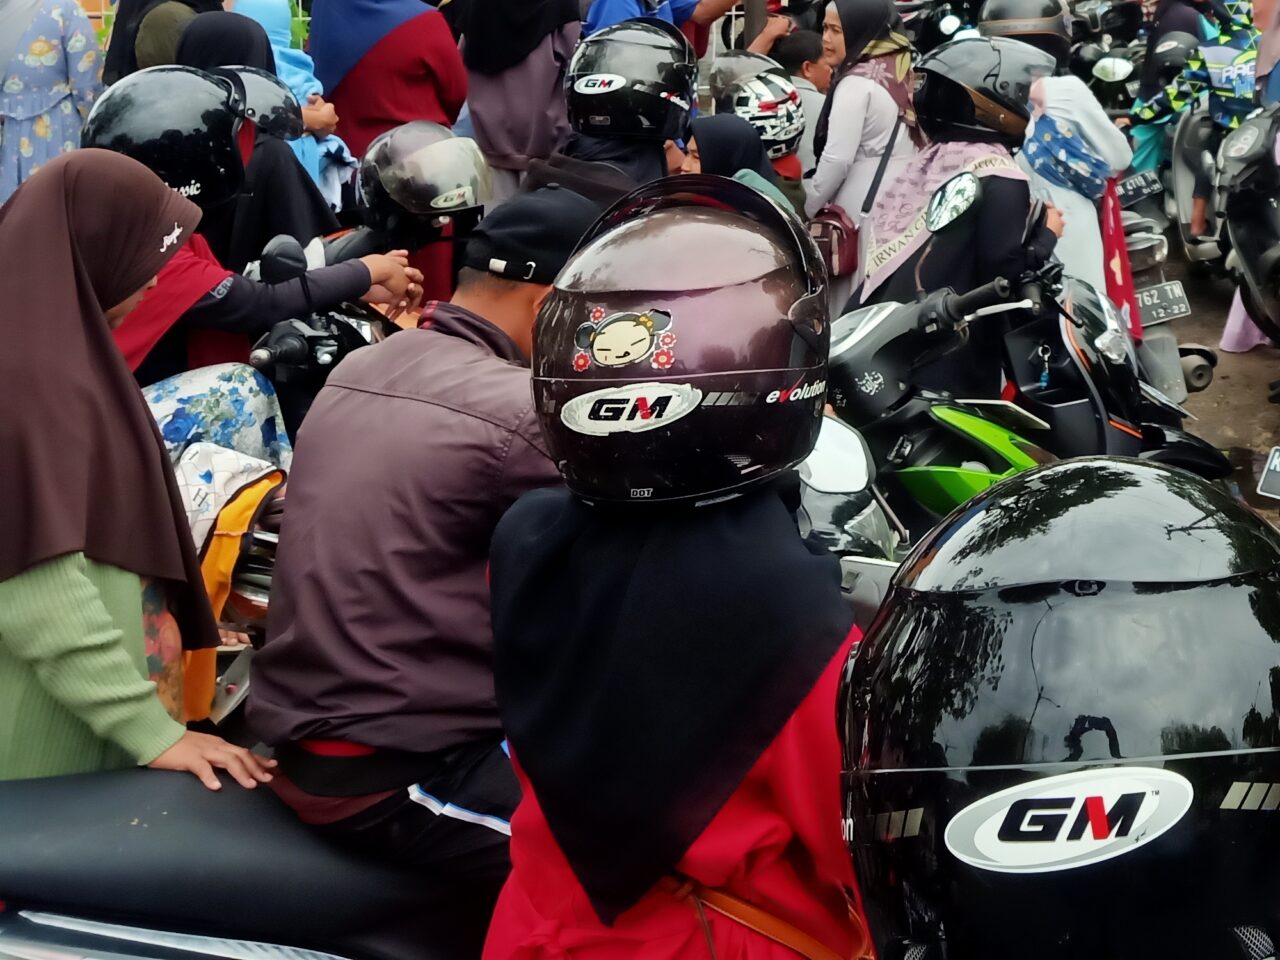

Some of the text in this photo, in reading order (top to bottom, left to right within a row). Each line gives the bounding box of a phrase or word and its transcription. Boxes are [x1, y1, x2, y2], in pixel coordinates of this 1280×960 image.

[584, 78, 614, 88] GM
[1136, 283, 1183, 308] 762 TN
[587, 395, 673, 422] GM
[765, 372, 827, 404] evolution
[631, 489, 653, 497] DOT
[997, 791, 1147, 843] GM
